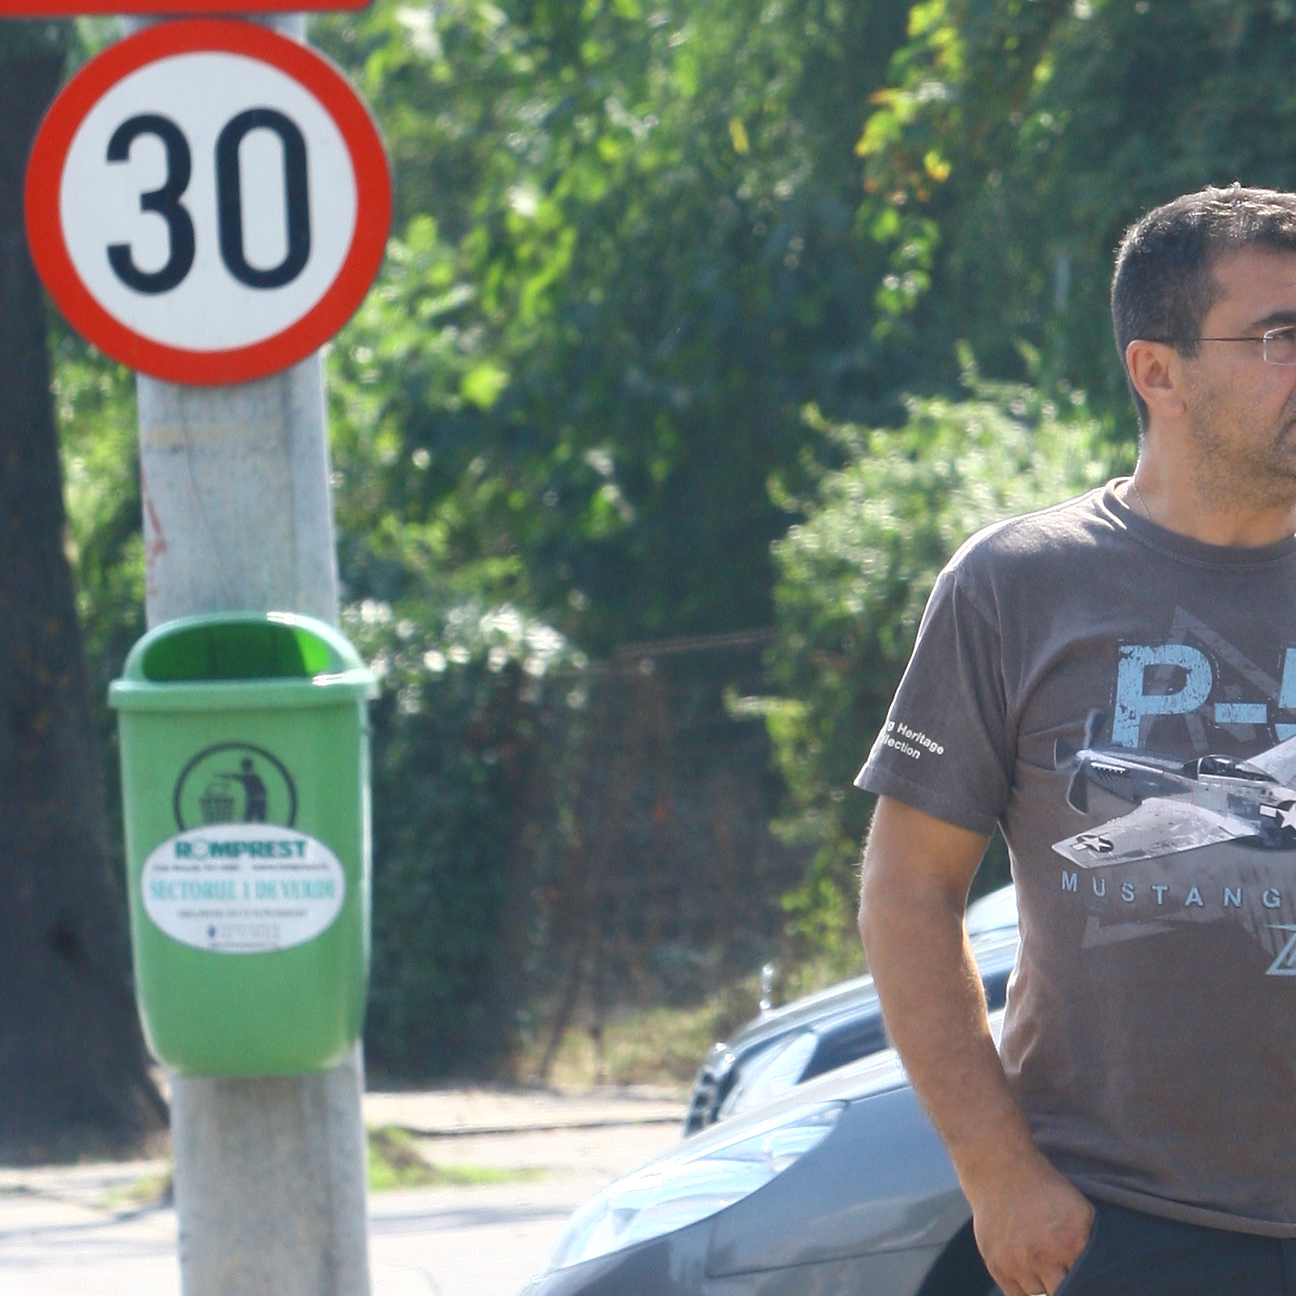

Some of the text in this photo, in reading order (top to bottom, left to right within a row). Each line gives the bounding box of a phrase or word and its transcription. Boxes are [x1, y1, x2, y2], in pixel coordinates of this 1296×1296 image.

[106, 107, 311, 296] 30
[897, 723, 945, 755] Heritage
[1061, 870, 1281, 909] MUSTANG
